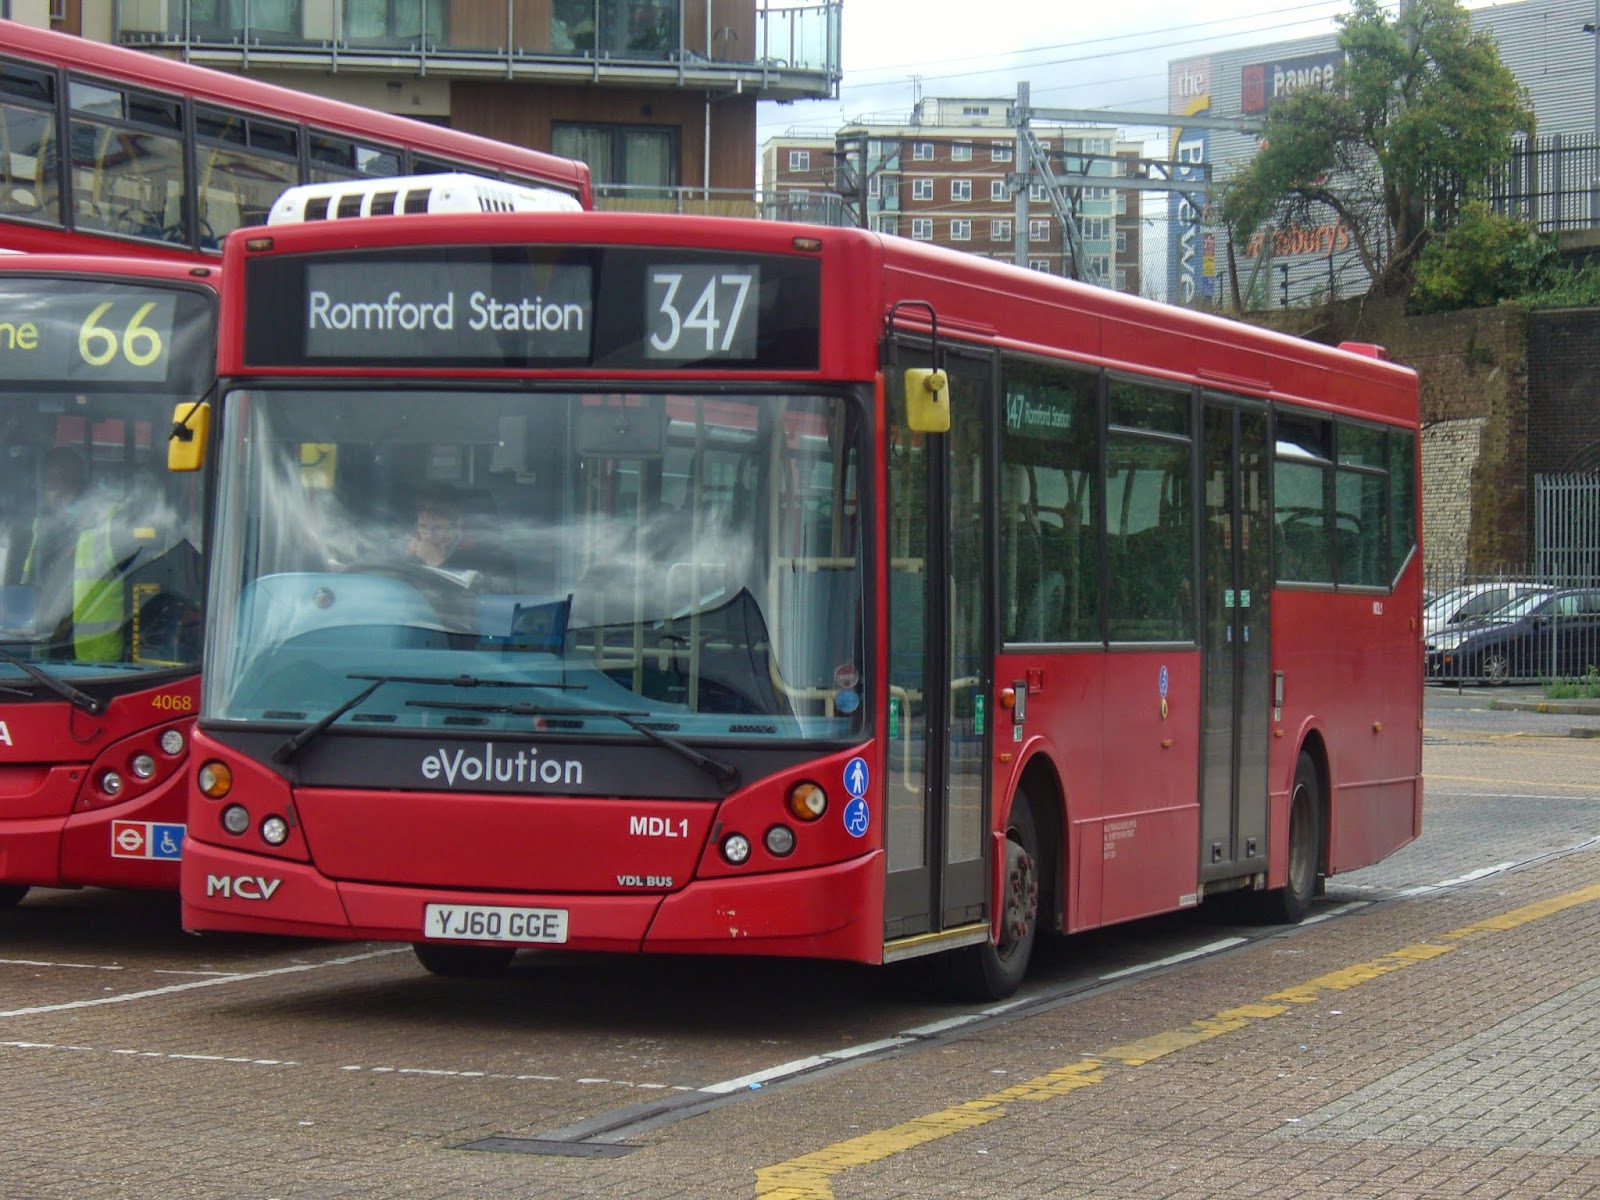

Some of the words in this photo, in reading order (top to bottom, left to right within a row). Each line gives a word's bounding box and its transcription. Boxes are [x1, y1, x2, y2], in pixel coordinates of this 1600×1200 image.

[1178, 68, 1204, 97] the
[309, 291, 454, 330] Romford
[468, 291, 584, 332] Station
[650, 274, 752, 352] 347
[78, 302, 162, 366] 66
[152, 695, 192, 711] 4068
[421, 742, 583, 786] eVolution
[629, 816, 689, 838] MDL1
[206, 874, 282, 900] MCV
[616, 875, 644, 887] VDL
[646, 876, 673, 888] BUS
[438, 910, 501, 937] YJ60
[508, 913, 559, 939] GGE
